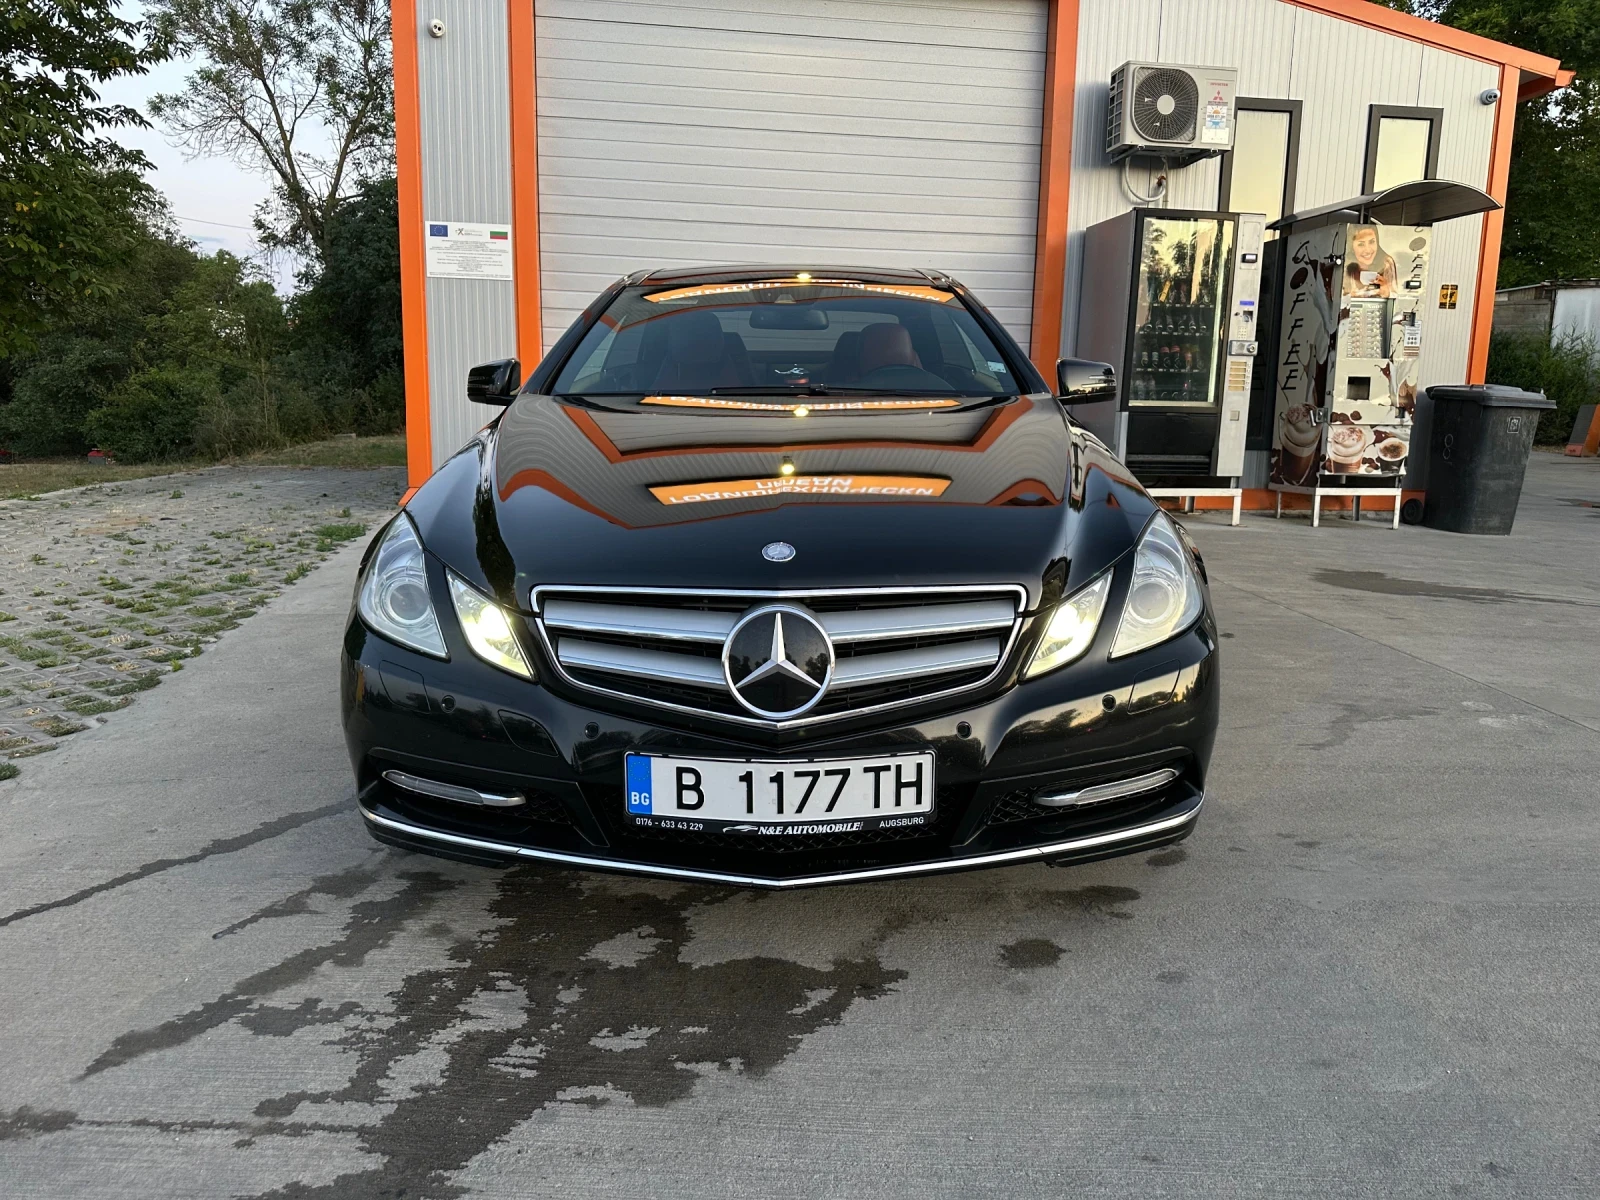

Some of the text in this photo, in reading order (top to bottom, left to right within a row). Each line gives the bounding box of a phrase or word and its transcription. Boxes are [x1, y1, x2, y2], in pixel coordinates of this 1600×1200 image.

[1281, 240, 1310, 390] COFFEE
[676, 762, 923, 814] B 1177 TH
[631, 791, 650, 806] BG
[636, 817, 653, 826] 0176
[660, 820, 676, 829] 633
[678, 822, 688, 830] 43
[689, 823, 704, 831] 229
[758, 826, 783, 835] N&E
[784, 821, 860, 835] AUTOMOBILE
[879, 816, 924, 828] AUGSBURG
